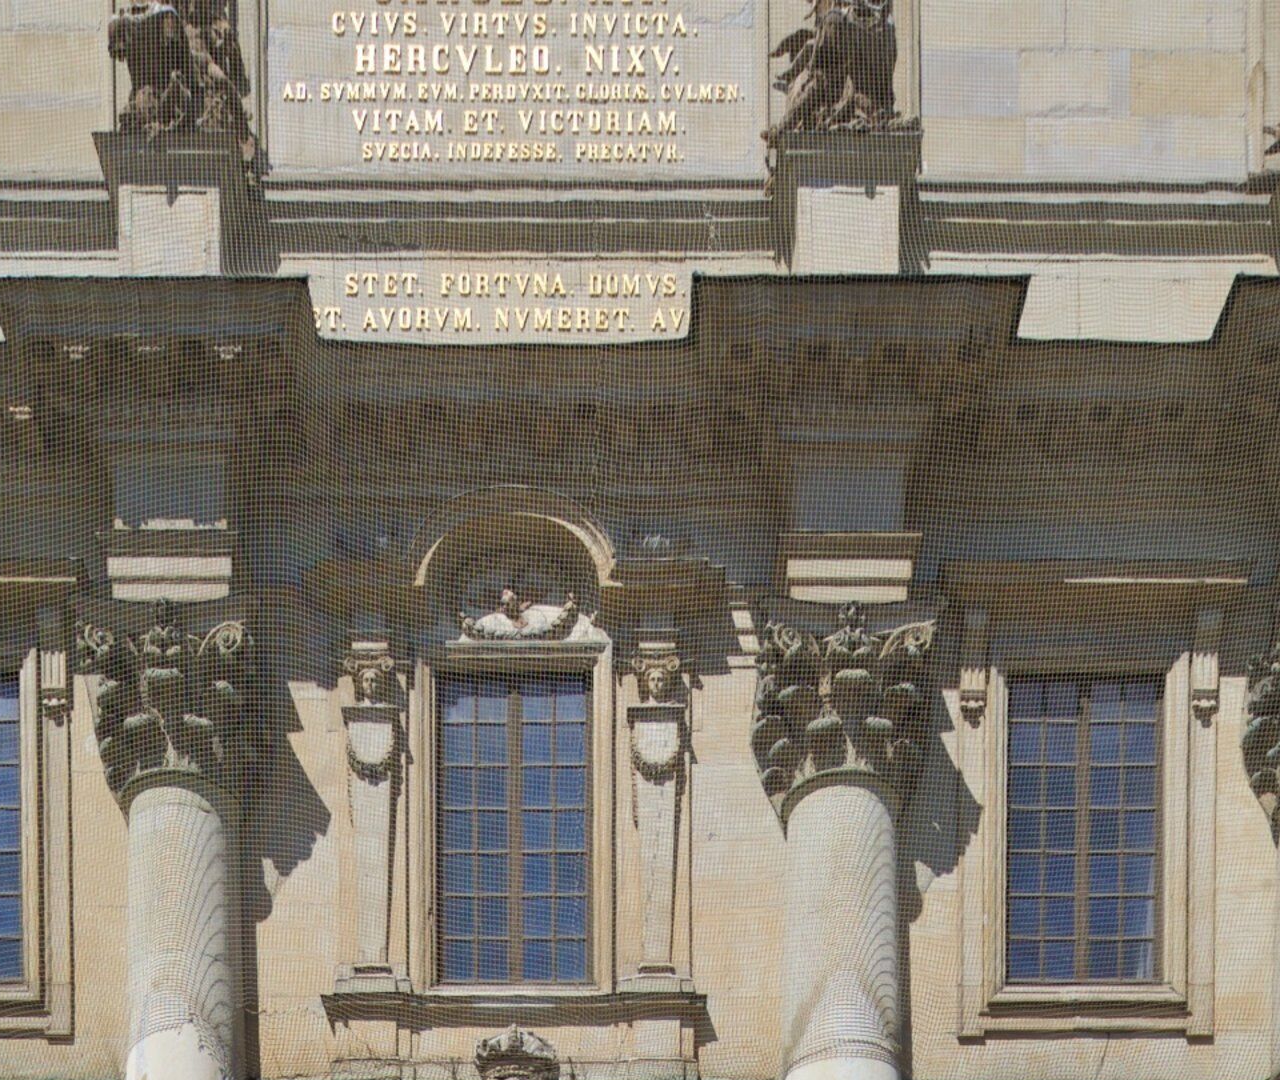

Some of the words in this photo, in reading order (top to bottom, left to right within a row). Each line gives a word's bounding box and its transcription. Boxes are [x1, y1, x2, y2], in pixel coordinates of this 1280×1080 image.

[331, 11, 429, 37] CVIVS.
[440, 12, 557, 38] VIRTVS.
[569, 12, 699, 38] INVICTA.
[355, 44, 562, 75] HERCVLEO.
[585, 45, 680, 76] NIXV.
[283, 82, 313, 102] AD.
[320, 82, 414, 102] SVMMVM.
[418, 82, 465, 102] EVM.
[660, 83, 746, 103] CVLMEN.
[352, 109, 453, 134] VITAM.
[464, 109, 506, 134] ET.
[518, 110, 687, 135] VICTORIAM.
[362, 142, 440, 162] SVECIA.
[448, 142, 563, 162] INDEFESSE.
[575, 143, 685, 162] PRECATVR.
[345, 272, 424, 297] STET.
[440, 273, 575, 297] FORTVNA.
[589, 273, 686, 298] DOMVS.
[363, 307, 481, 331] AVORVM.
[494, 308, 635, 332] NVMERET.
